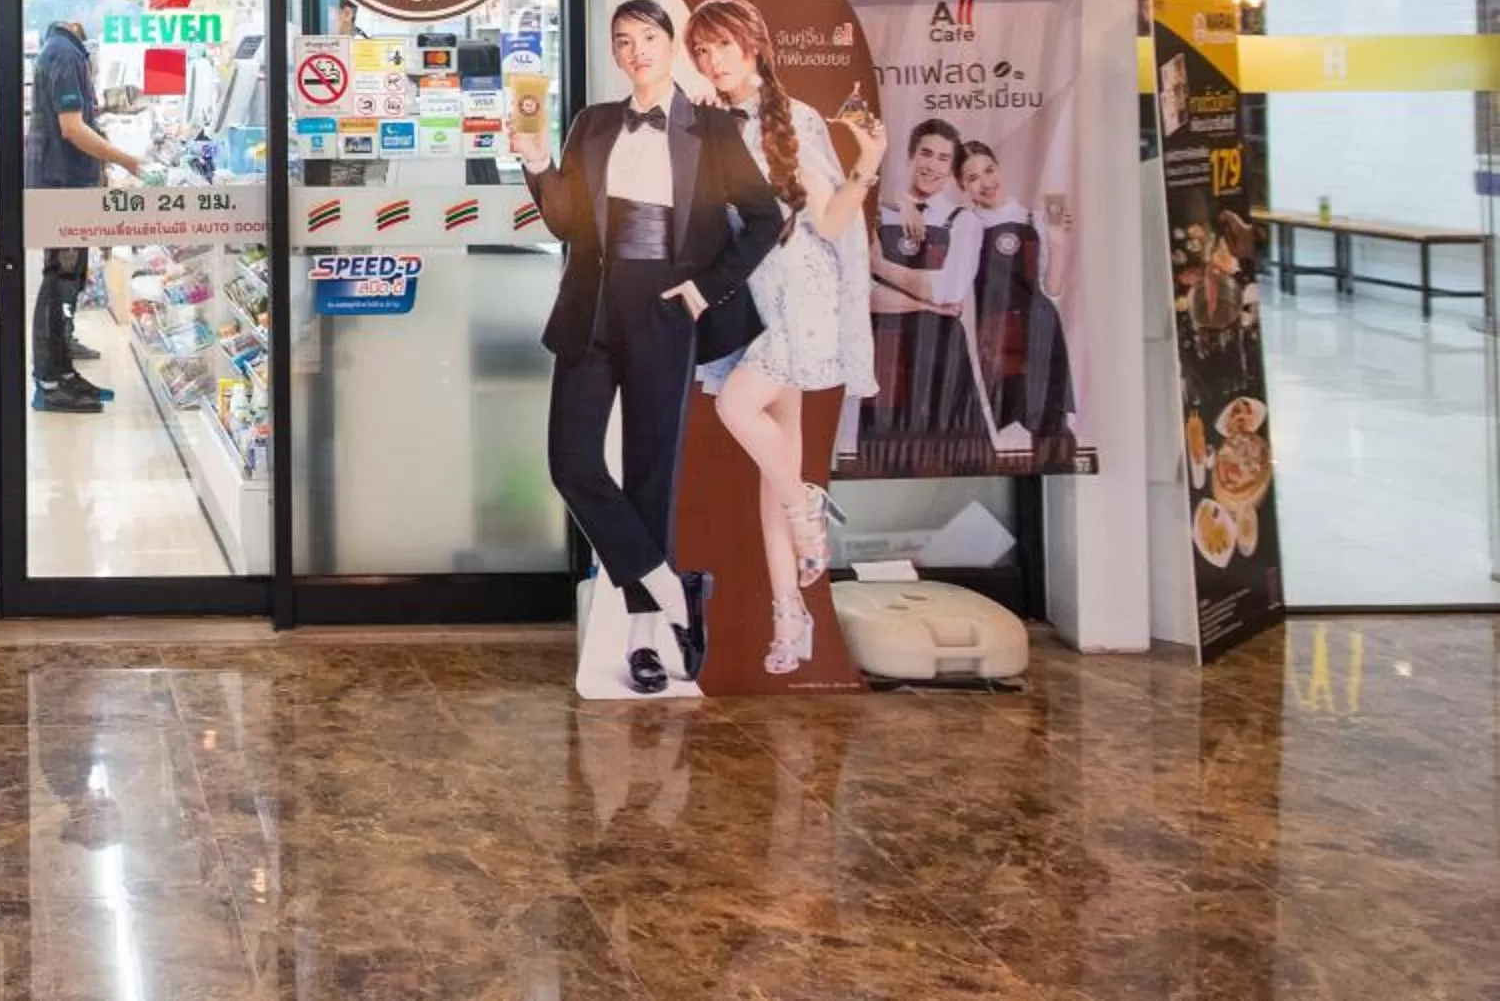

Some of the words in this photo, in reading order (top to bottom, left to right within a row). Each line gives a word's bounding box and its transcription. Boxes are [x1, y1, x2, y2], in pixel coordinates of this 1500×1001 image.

[102, 189, 145, 212] เปิด
[158, 195, 185, 211] 24
[311, 256, 422, 277] SPEED-D
